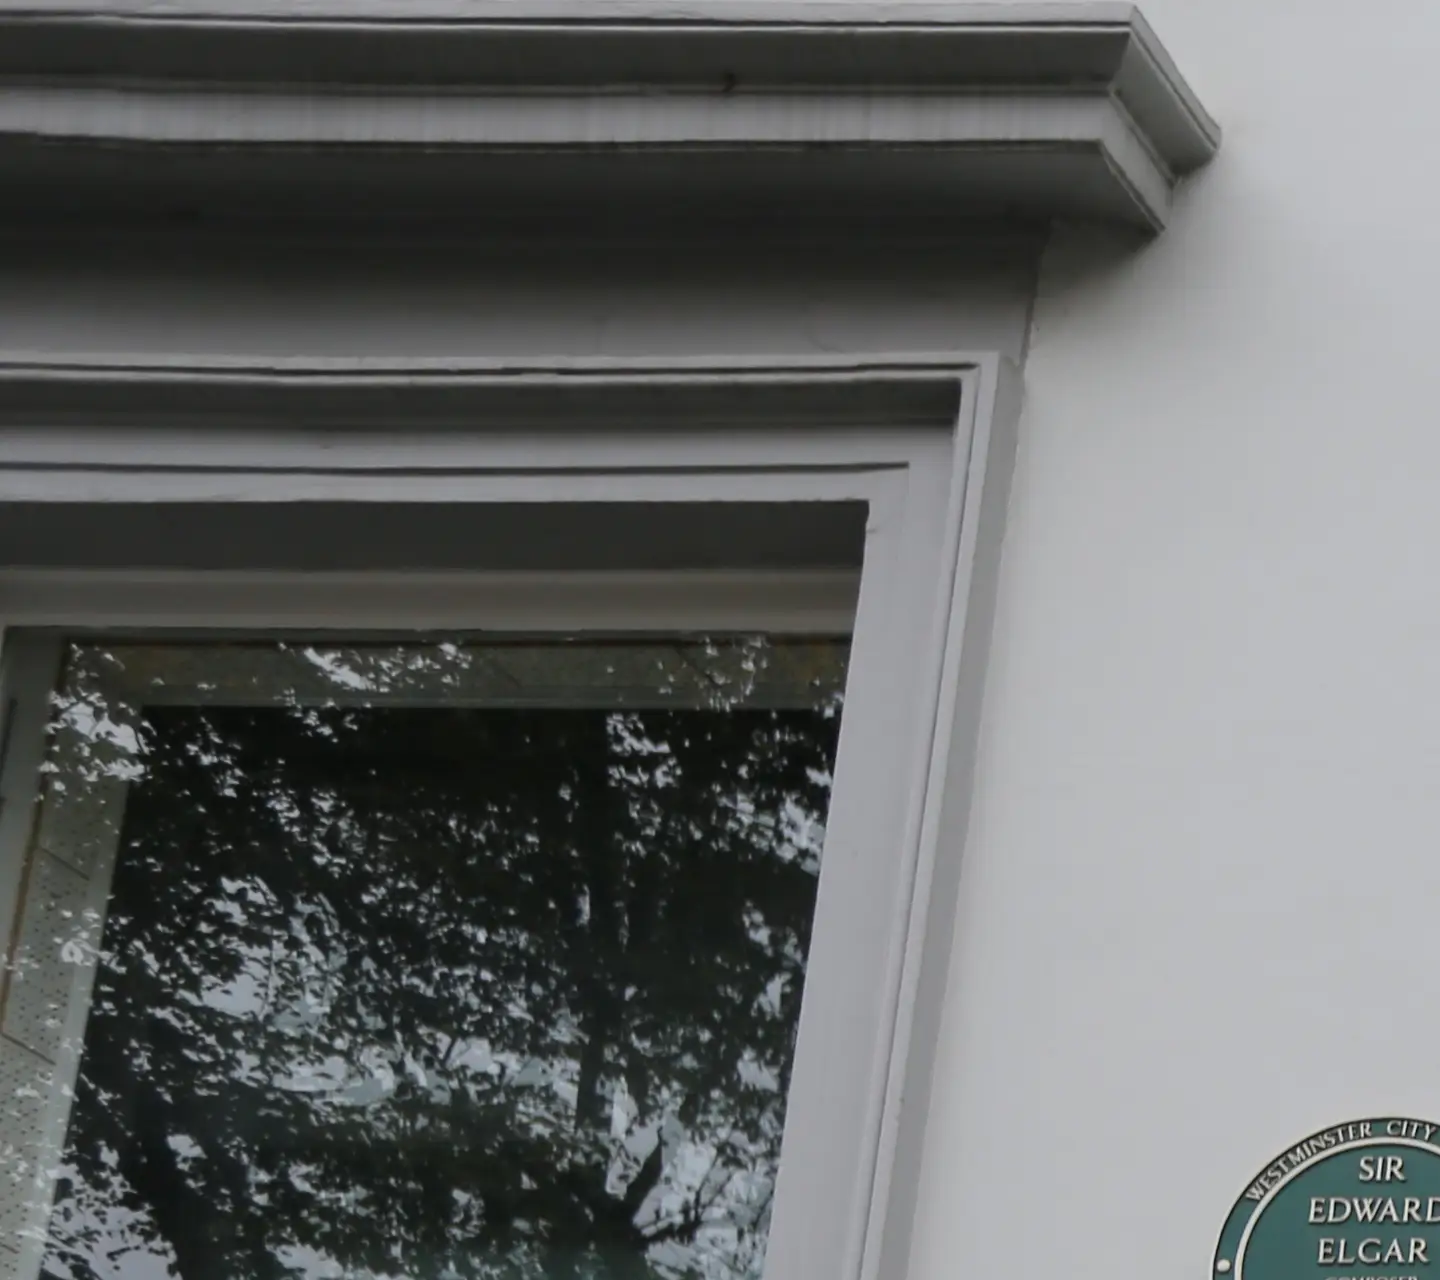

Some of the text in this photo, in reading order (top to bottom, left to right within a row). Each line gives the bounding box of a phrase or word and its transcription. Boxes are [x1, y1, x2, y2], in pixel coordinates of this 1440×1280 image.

[1246, 1122, 1372, 1203] WESTMINSTER
[1386, 1120, 1436, 1140] CITY
[1359, 1156, 1406, 1182] SIR
[1317, 1238, 1429, 1264] ELGAR
